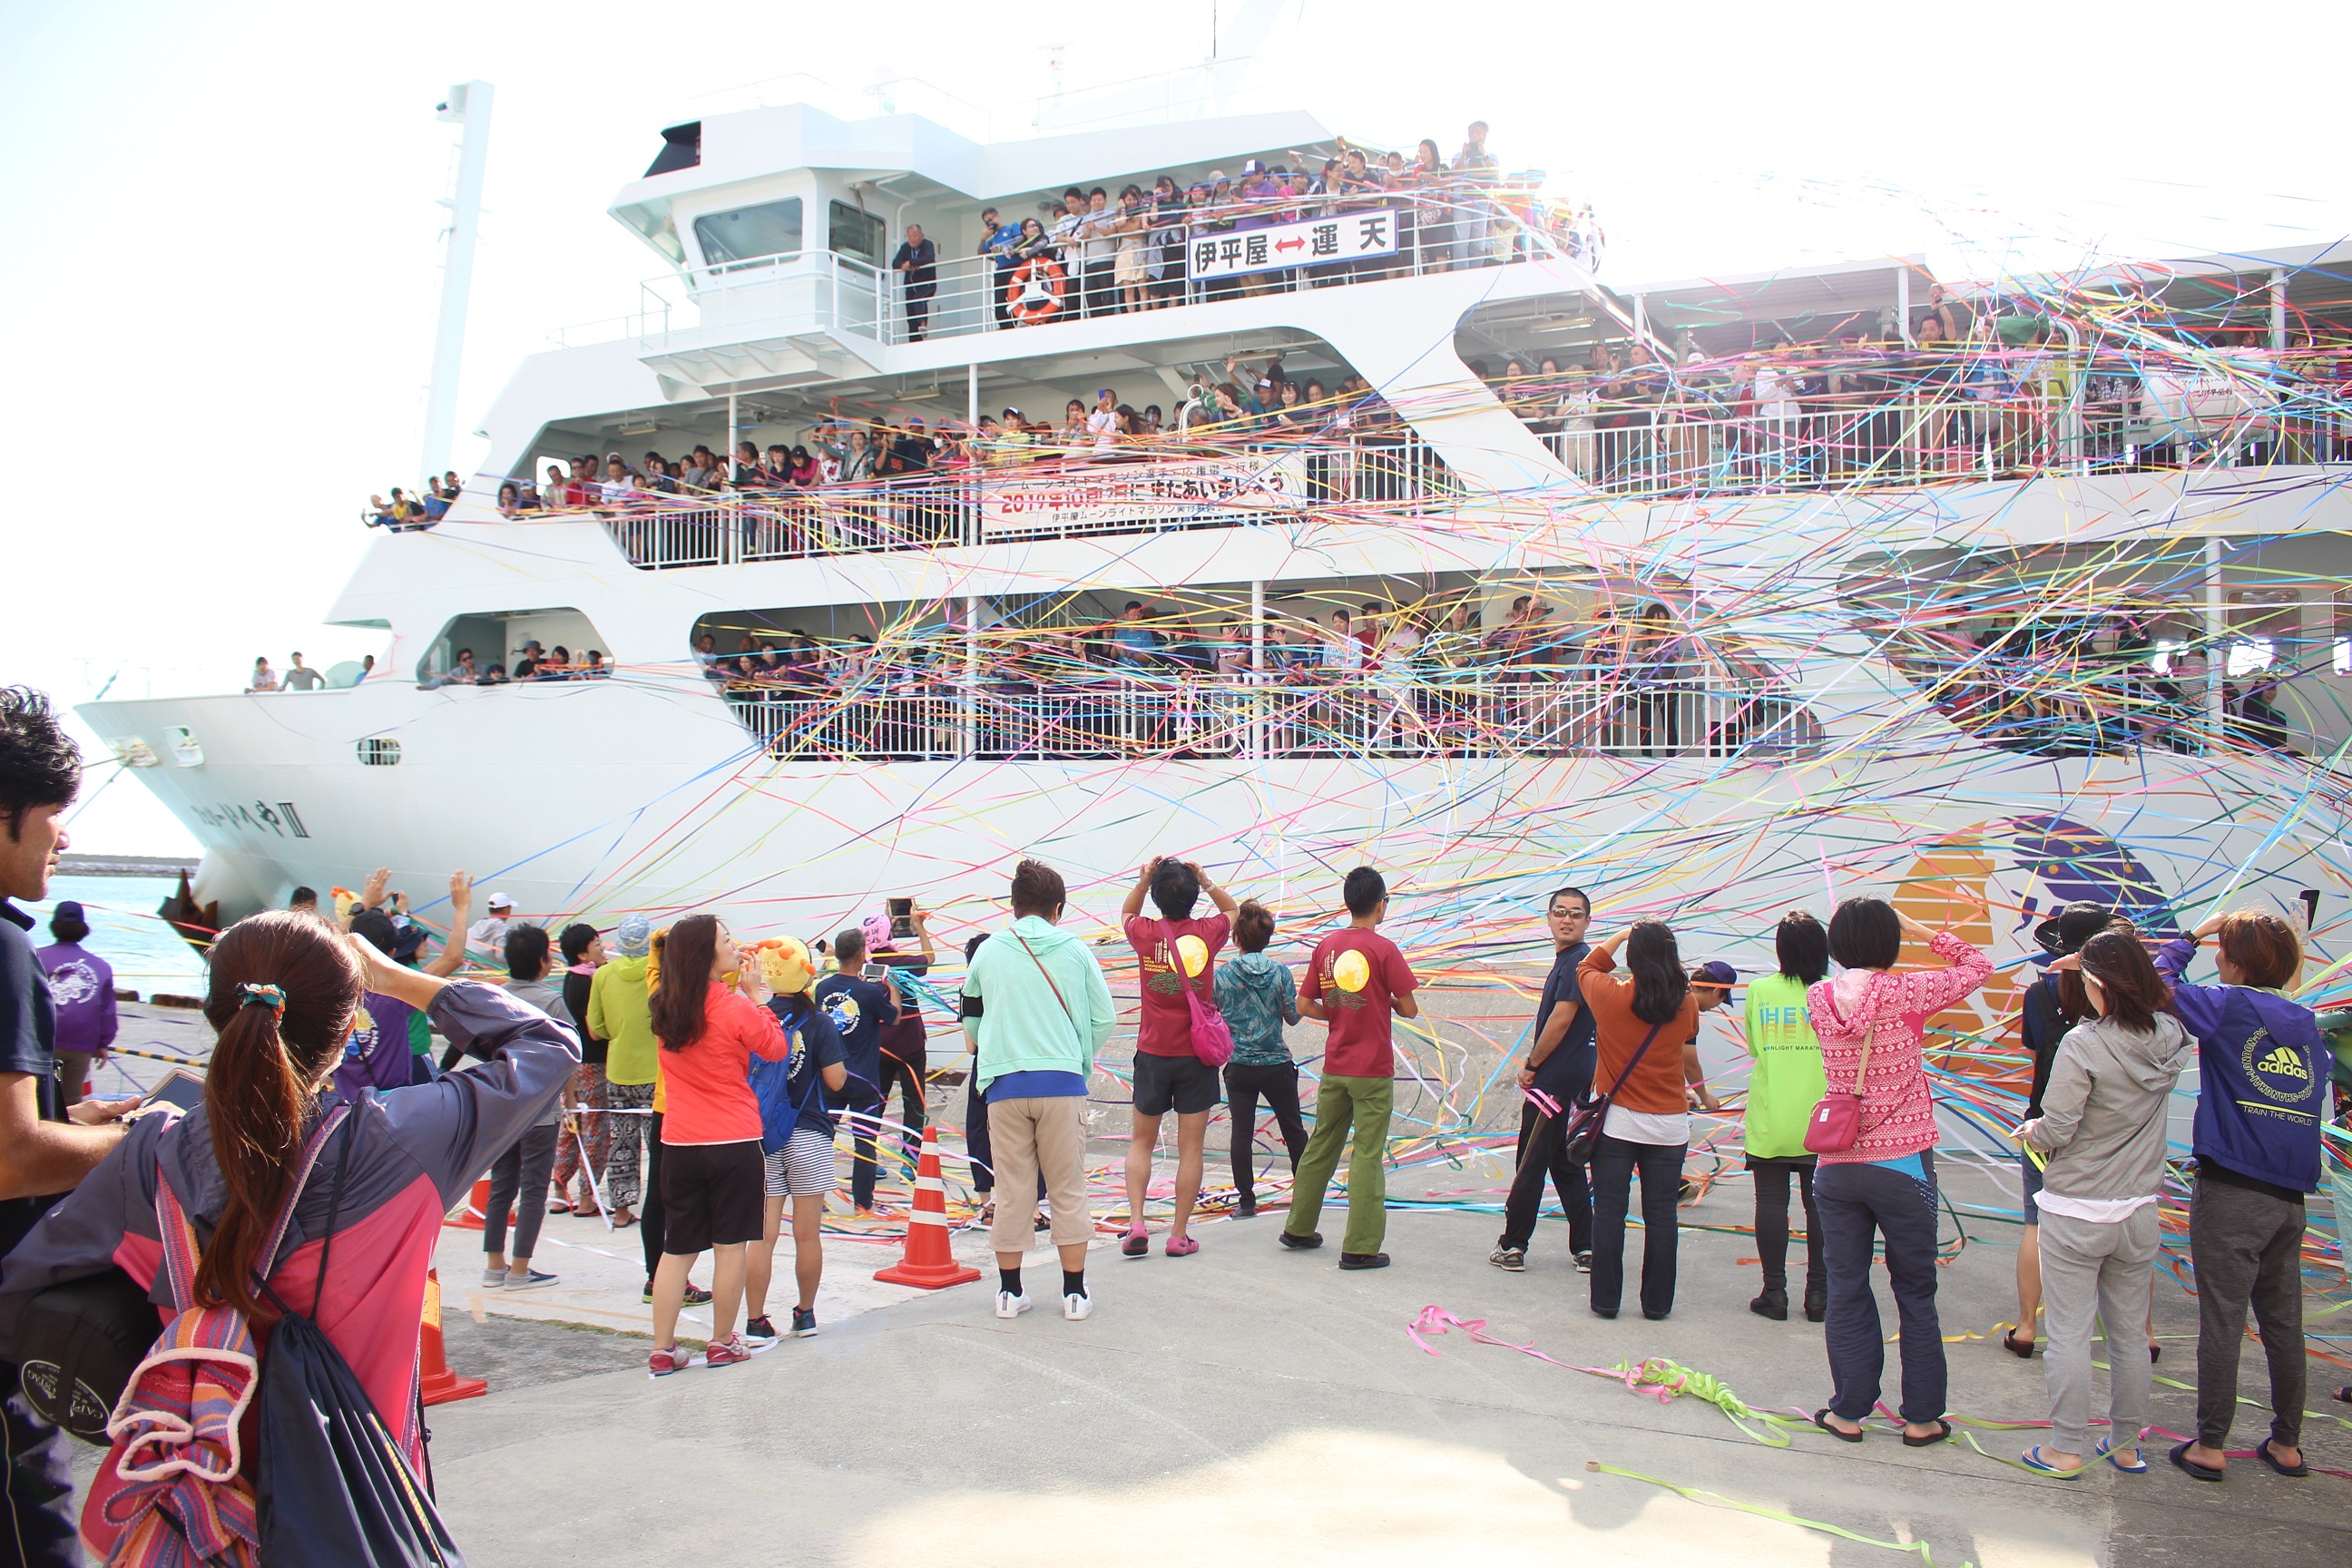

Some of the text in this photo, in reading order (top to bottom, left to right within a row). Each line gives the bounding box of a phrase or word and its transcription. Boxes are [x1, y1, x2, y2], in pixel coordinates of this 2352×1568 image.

[1195, 234, 1269, 273] 伊平屋
[1759, 1006, 1810, 1026] IHEY
[2257, 1060, 2309, 1080] adidas
[2242, 1105, 2312, 1126] TRAIN THE WORLD
